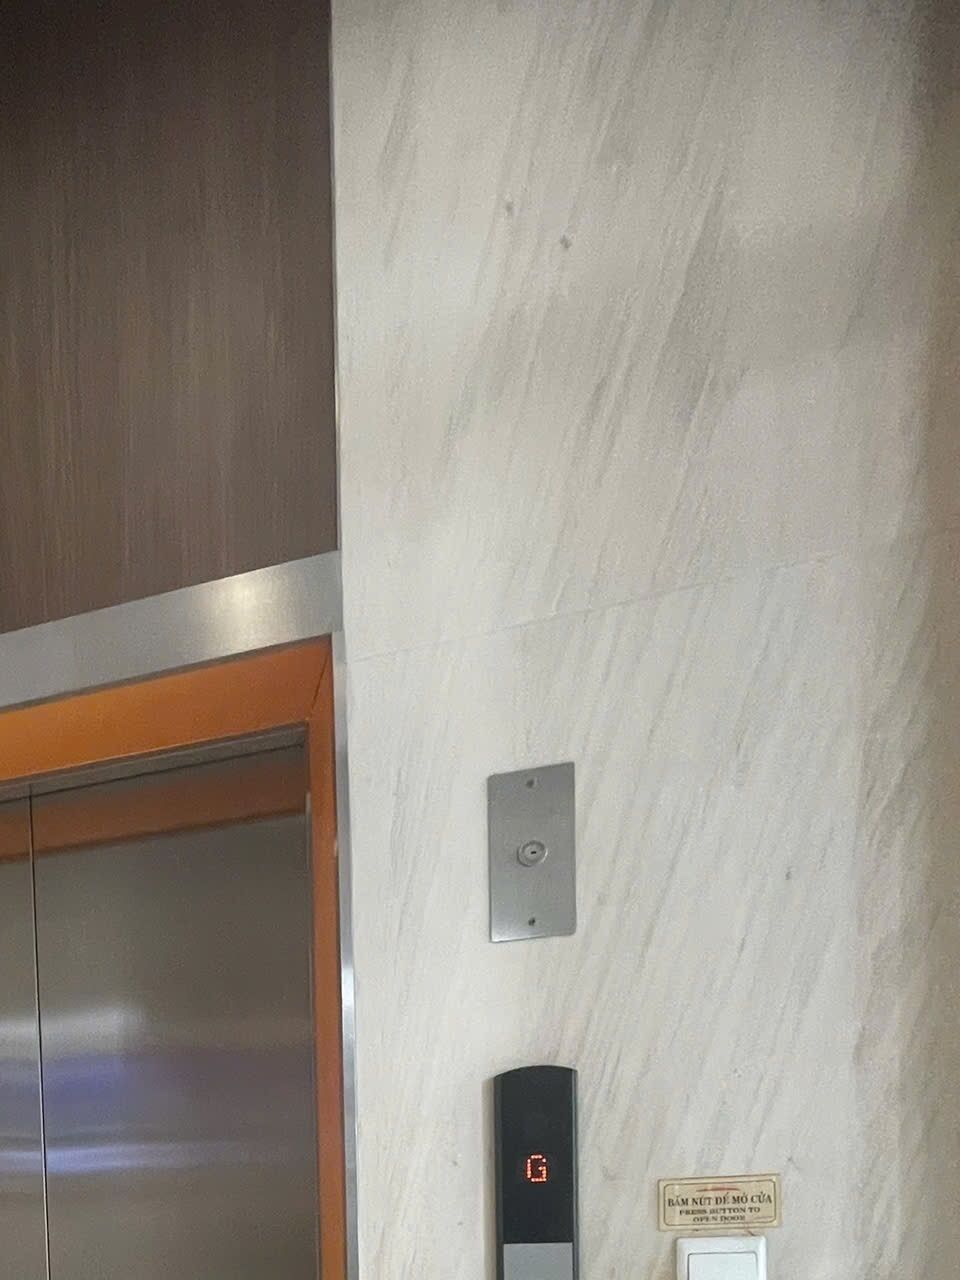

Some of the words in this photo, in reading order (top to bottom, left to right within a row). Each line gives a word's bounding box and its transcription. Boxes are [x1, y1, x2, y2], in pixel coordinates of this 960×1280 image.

[527, 1155, 547, 1182] G
[679, 1208, 707, 1216] PRESS
[709, 1207, 746, 1215] BUTTON
[692, 1215, 719, 1223] OPEN
